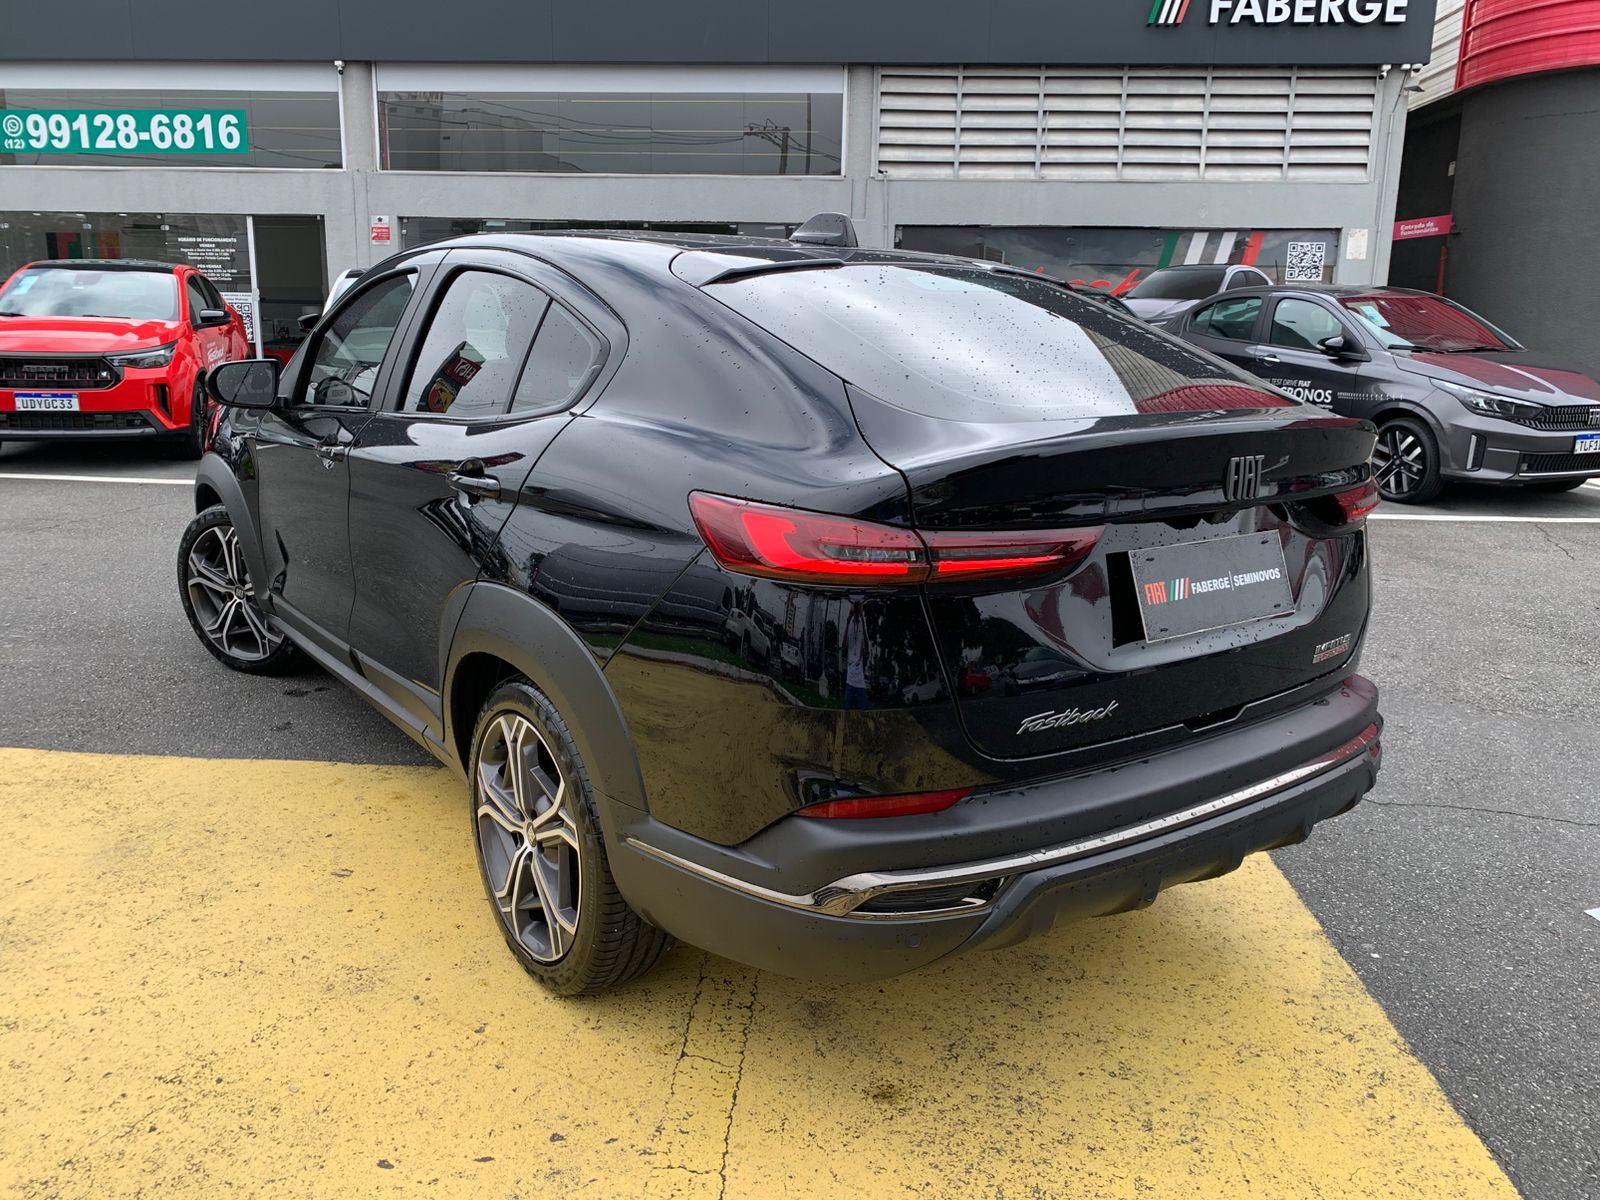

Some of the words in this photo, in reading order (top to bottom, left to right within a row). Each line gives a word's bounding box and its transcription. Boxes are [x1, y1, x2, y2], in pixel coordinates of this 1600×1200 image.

[1208, 0, 1408, 24] FABERGE
[4, 139, 25, 150] (12)
[25, 113, 241, 149] 99128-6816
[1400, 222, 1425, 231] Entrada
[22, 365, 69, 373] ABARTH
[1297, 380, 1312, 388] FIAT
[1580, 440, 1600, 452] TLF1
[1226, 454, 1265, 501] FIAT
[1143, 581, 1167, 605] FIAT
[1191, 576, 1231, 594] FABERGE
[1233, 567, 1281, 587] SEMINOVOS
[1016, 700, 1119, 735] Fastback
